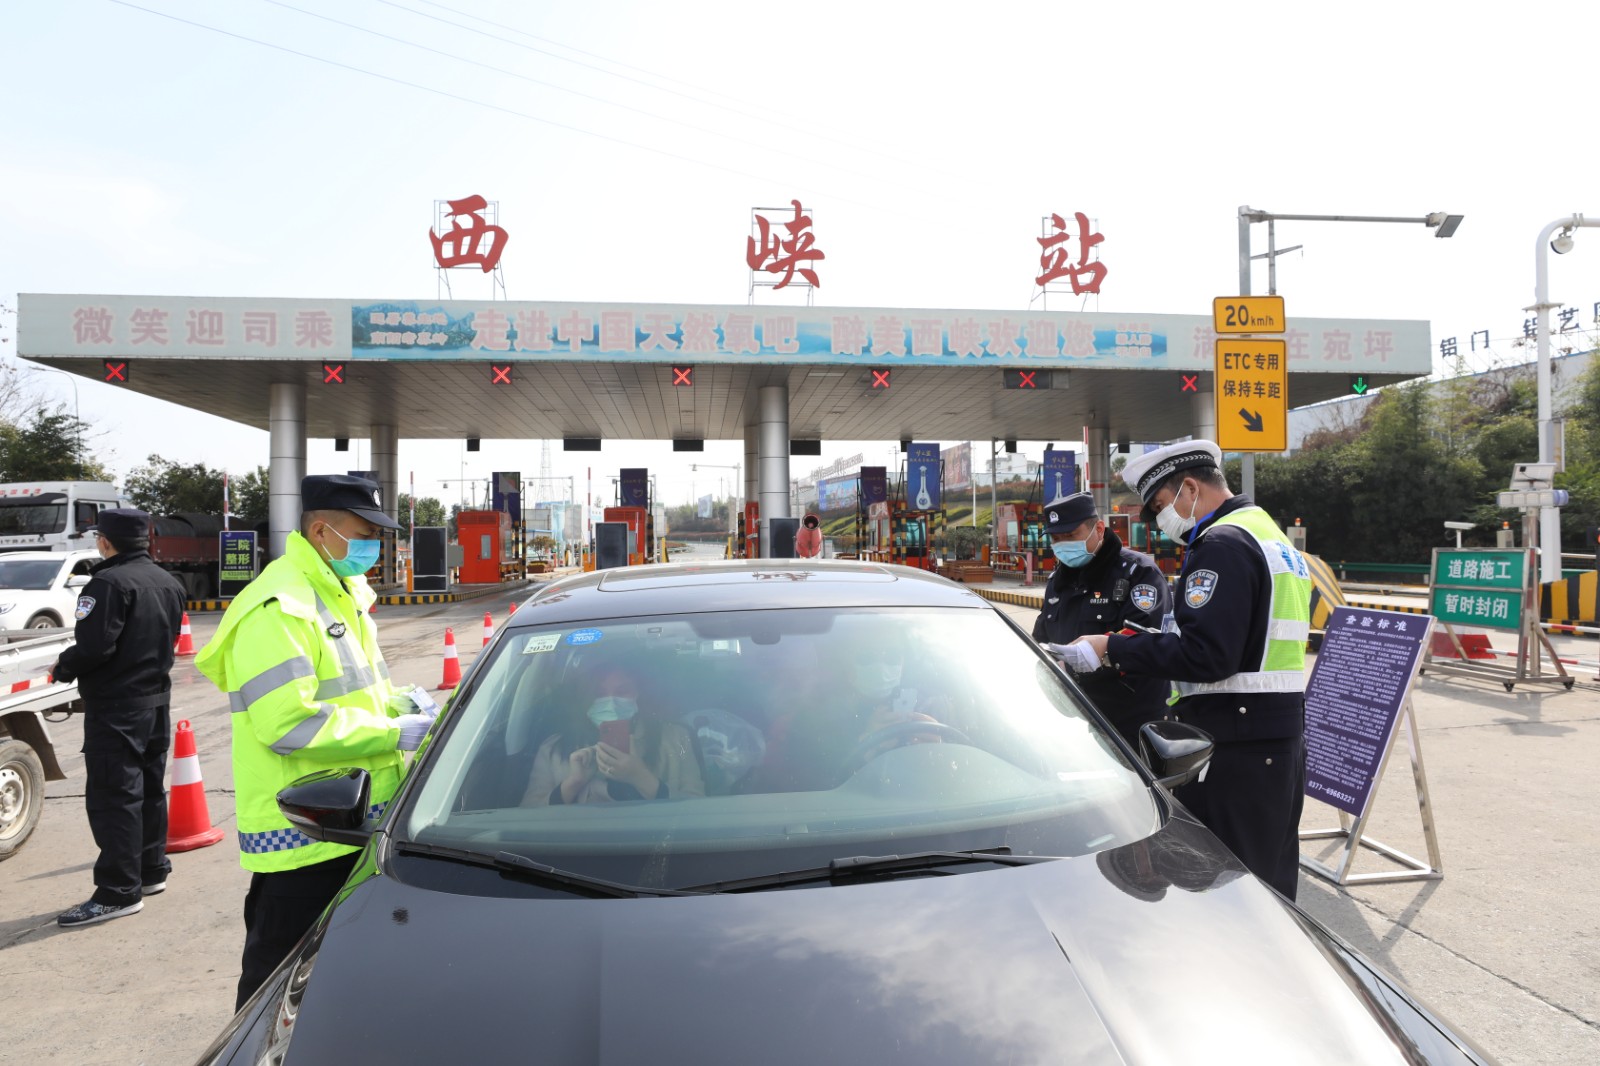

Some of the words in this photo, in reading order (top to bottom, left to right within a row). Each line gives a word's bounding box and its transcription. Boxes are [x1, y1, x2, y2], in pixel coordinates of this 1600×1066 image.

[429, 194, 1108, 296] 西峡站
[73, 306, 334, 348] 微笑迎司乘
[471, 308, 800, 354] 走进中国天然氧吧
[831, 314, 1098, 358] 醉美西峡欢迎您
[1193, 326, 1394, 362] 满在宛坪
[1223, 380, 1281, 399] 保持车距
[225, 539, 251, 551] 三院
[225, 553, 251, 565] 整形
[1448, 559, 1512, 581] 道路施工
[1445, 593, 1509, 620] 暂时封闭
[1345, 614, 1408, 632] 查验标准
[526, 645, 553, 653] 2020
